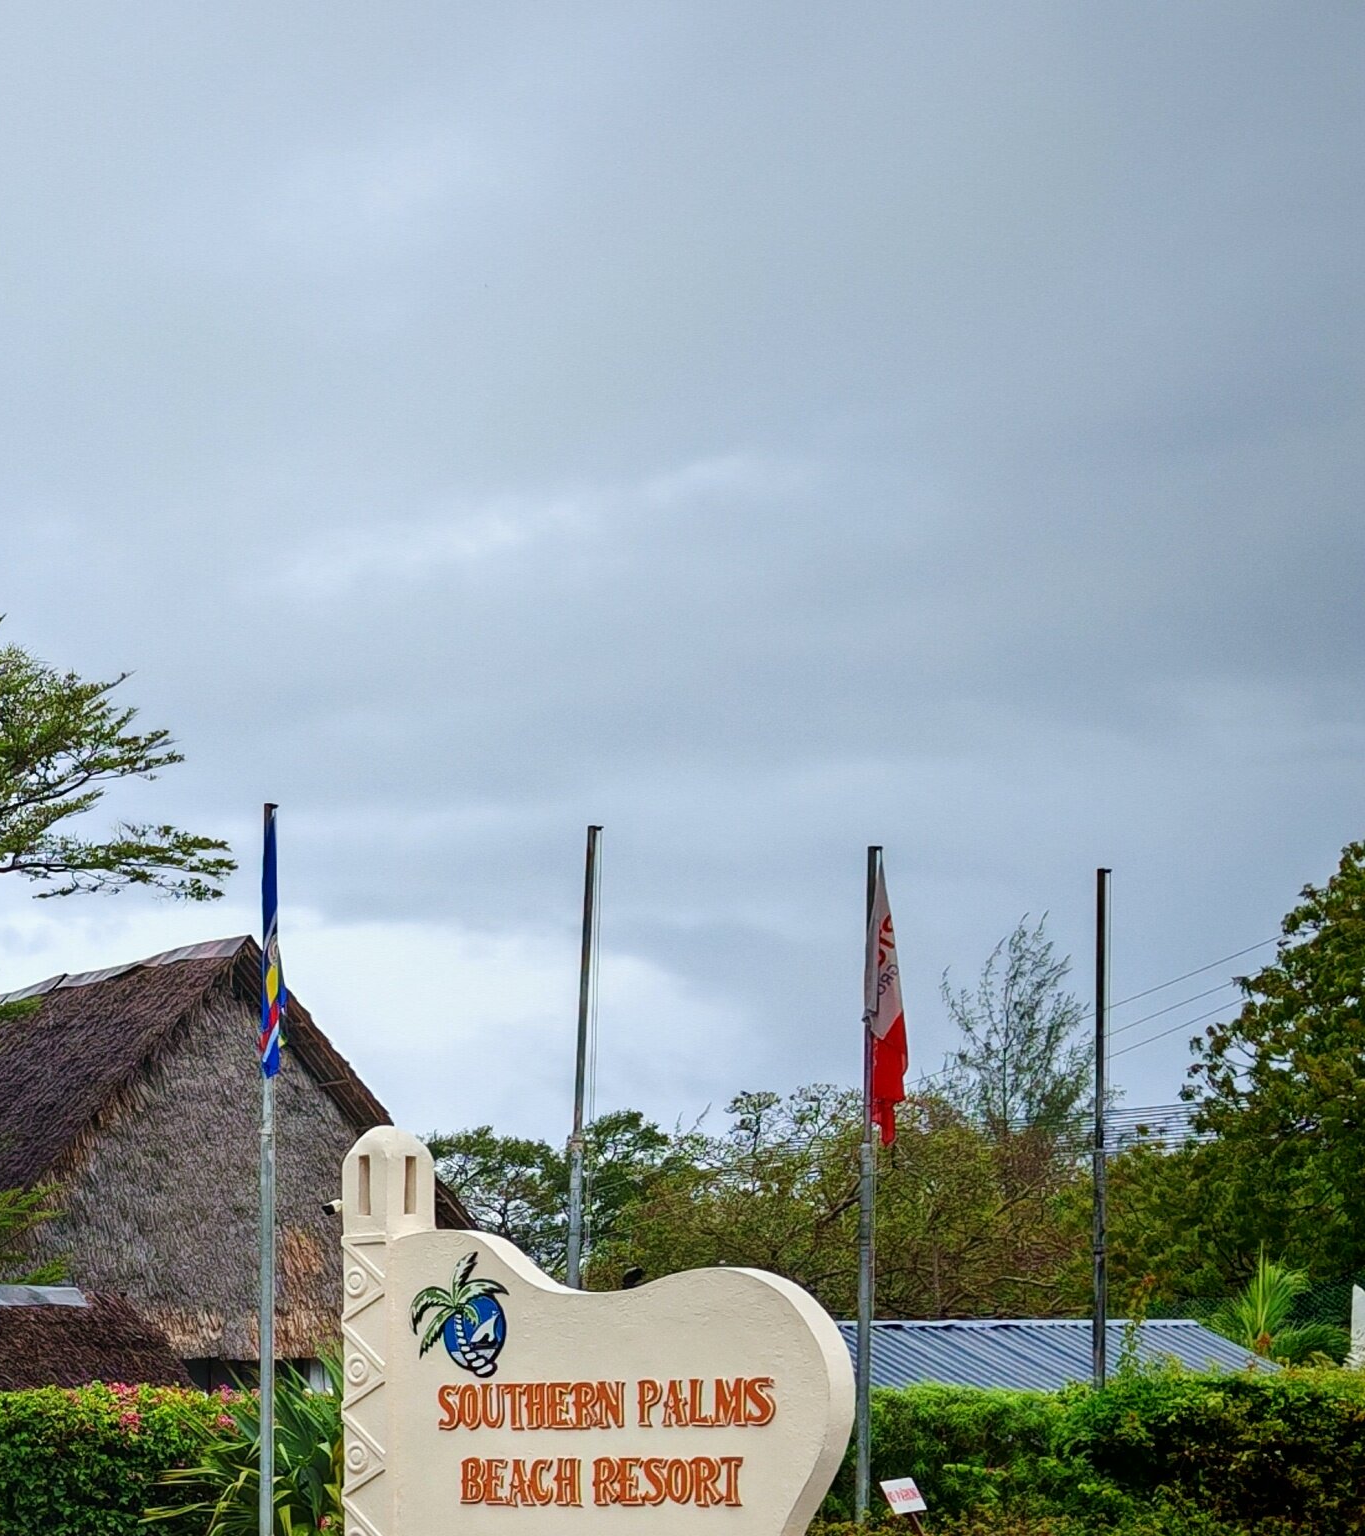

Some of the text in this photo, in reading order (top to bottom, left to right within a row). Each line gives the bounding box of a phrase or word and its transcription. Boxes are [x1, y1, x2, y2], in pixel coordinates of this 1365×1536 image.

[438, 1377, 776, 1431] SOUTHERN PALMS
[460, 1456, 744, 1508] BEACH RESORT
